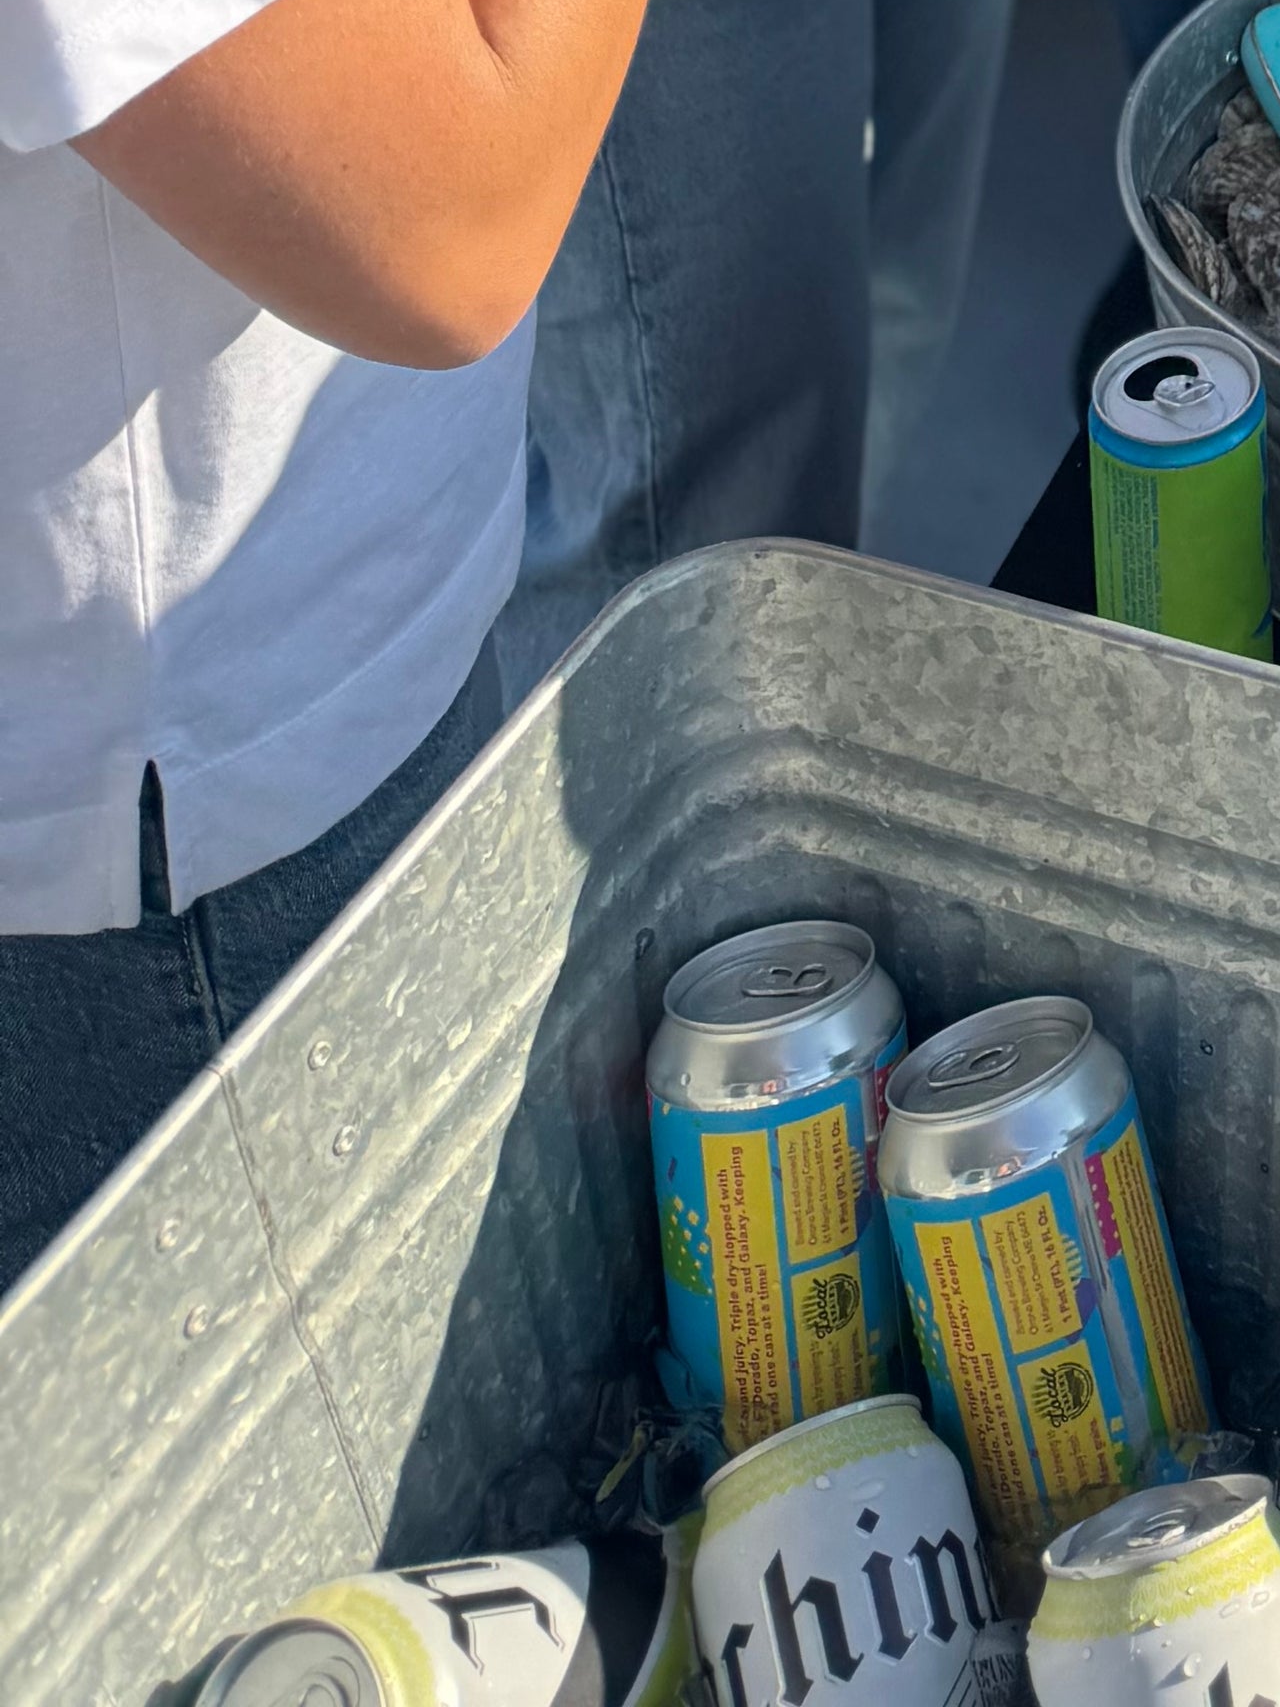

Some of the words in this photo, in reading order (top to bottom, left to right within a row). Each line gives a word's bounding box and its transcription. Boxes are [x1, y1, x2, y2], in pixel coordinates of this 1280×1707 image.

[716, 1168, 729, 1200] with
[730, 1146, 746, 1205] Keeping
[720, 1203, 740, 1287] dry-hopped
[993, 1230, 1005, 1247] by
[1005, 1220, 1022, 1265] Company
[1044, 1243, 1056, 1258] 16
[740, 1266, 752, 1293] and
[755, 1263, 768, 1300] time!
[932, 1258, 948, 1290] with
[941, 1236, 962, 1296] Keeping
[728, 1290, 744, 1331] Triple
[1057, 1288, 1070, 1313] Pint
[745, 1297, 758, 1344] Topaz,
[761, 1315, 772, 1329] at
[940, 1292, 970, 1375] dry-hopped
[764, 1332, 774, 1358] can
[766, 1361, 776, 1387] one
[968, 1355, 984, 1383] and
[980, 1352, 999, 1390] time!
[963, 1378, 980, 1420] Triple
[995, 1404, 1007, 1418] at
[1047, 1366, 1069, 1428] Local
[1000, 1421, 1013, 1447] can
[1007, 1449, 1021, 1477] one
